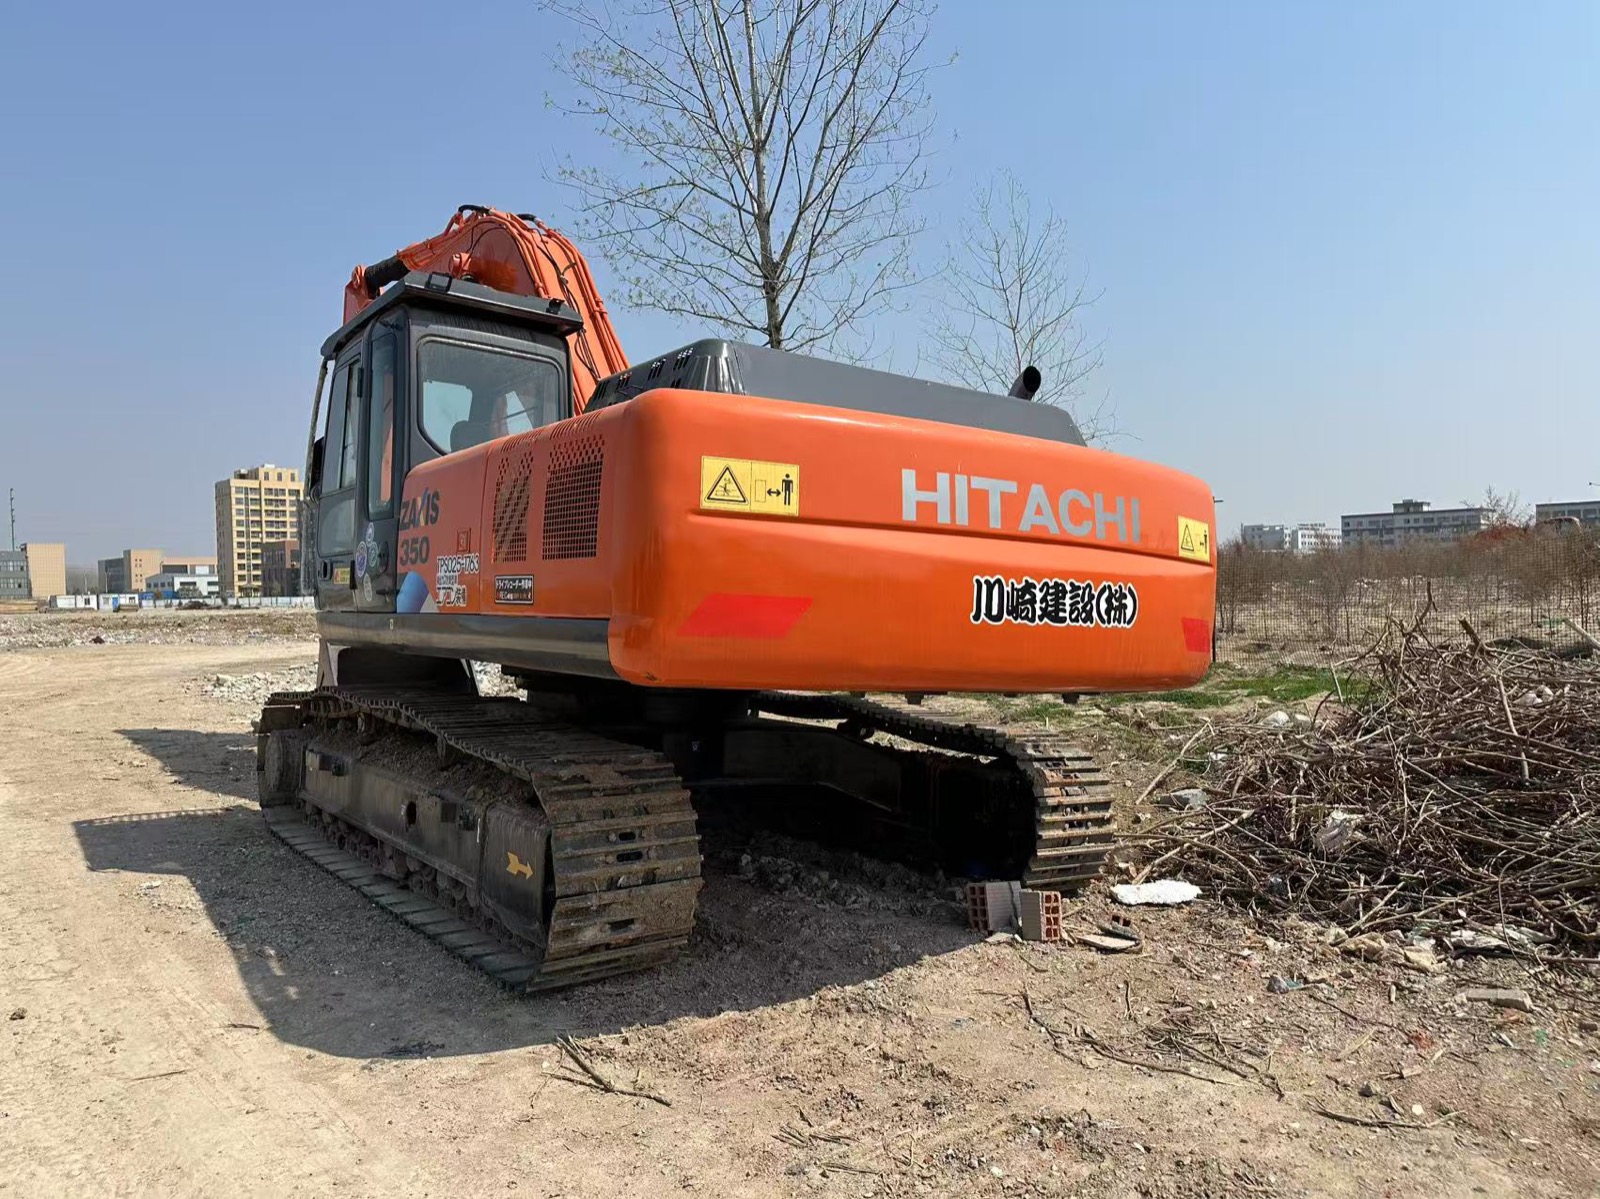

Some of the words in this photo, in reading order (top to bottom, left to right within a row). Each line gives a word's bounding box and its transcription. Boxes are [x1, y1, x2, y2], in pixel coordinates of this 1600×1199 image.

[400, 487, 440, 530] ZAXIS
[902, 468, 1140, 543] HITACHI
[400, 536, 430, 566] 350
